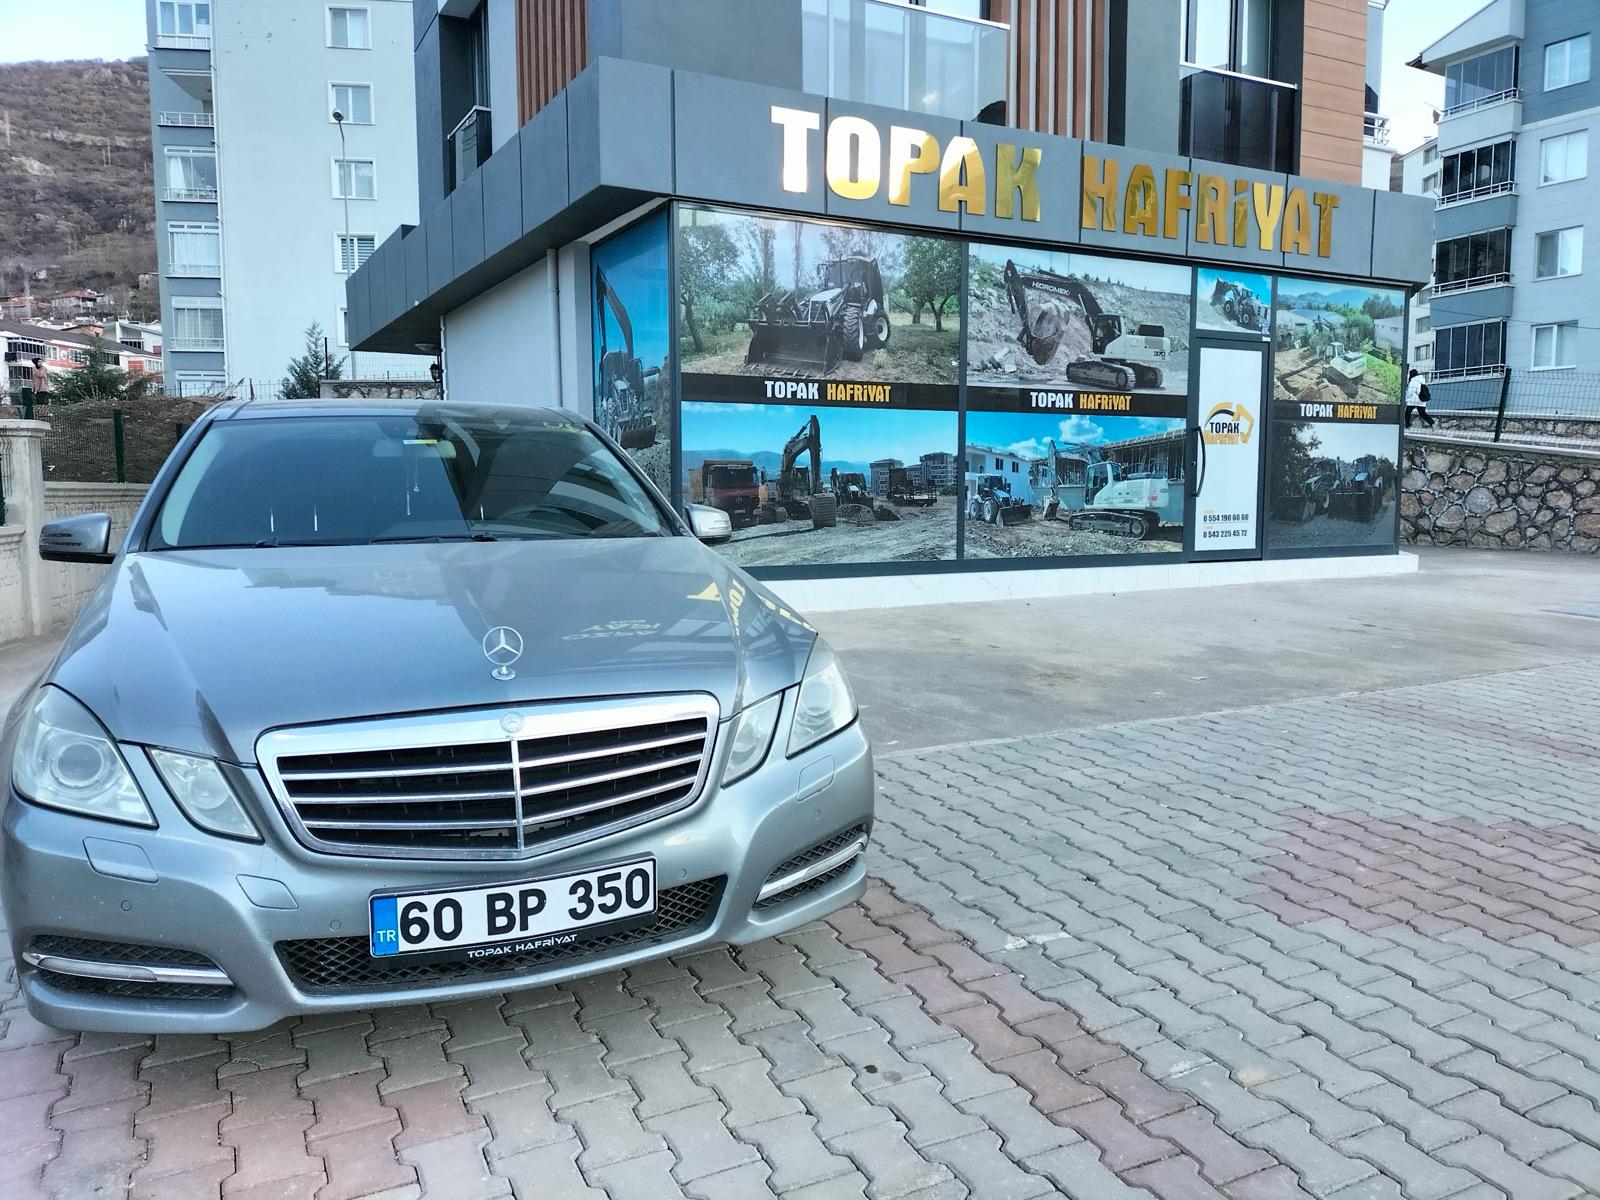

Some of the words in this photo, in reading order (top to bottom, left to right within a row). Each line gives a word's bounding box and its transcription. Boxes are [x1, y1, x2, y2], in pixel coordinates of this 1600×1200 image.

[770, 105, 1042, 222] TOPAK
[764, 380, 819, 400] TOPAK
[1030, 391, 1074, 409] TOPAK
[1300, 403, 1334, 418] TOPAK
[1210, 422, 1240, 434] TOPAK
[1203, 514, 1208, 522] 0
[1202, 530, 1208, 538] 0
[1232, 529, 1241, 537] 45
[400, 898, 463, 945] 60
[486, 888, 547, 936] BP
[568, 868, 650, 920] 350
[377, 930, 396, 942] TR
[467, 945, 513, 958] TOPAK
